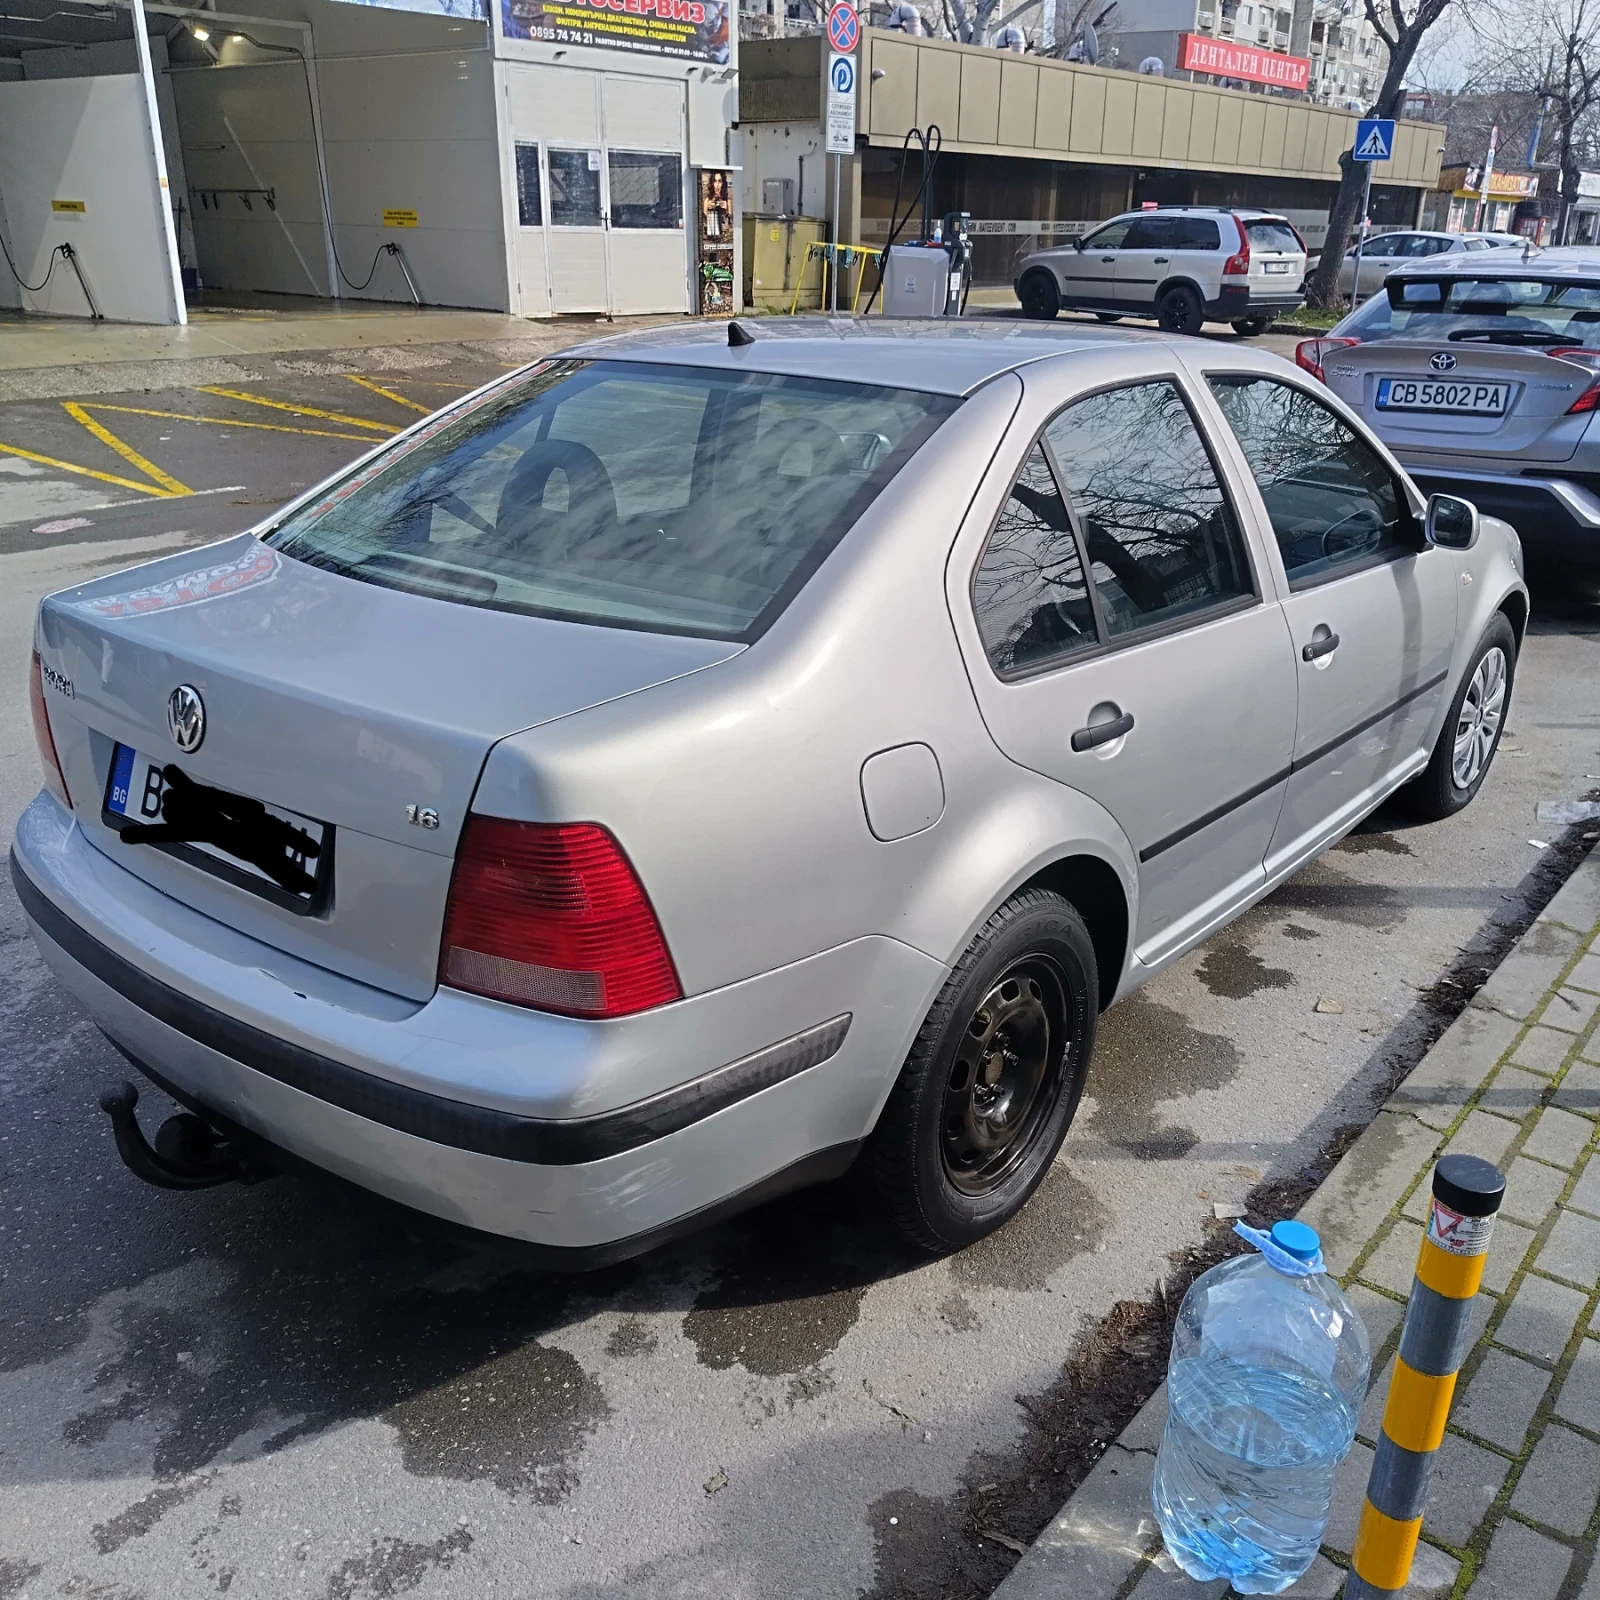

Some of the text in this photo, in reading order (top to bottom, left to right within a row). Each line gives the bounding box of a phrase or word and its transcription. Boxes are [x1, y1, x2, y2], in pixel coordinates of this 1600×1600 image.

[530, 25, 593, 44] 0895 74 74 21
[668, 22, 676, 31] НА
[1190, 43, 1306, 82] ДЕНТАЛЕН ЦЕНТЪР
[1392, 383, 1501, 409] CB 5802 PA
[112, 786, 127, 804] BG
